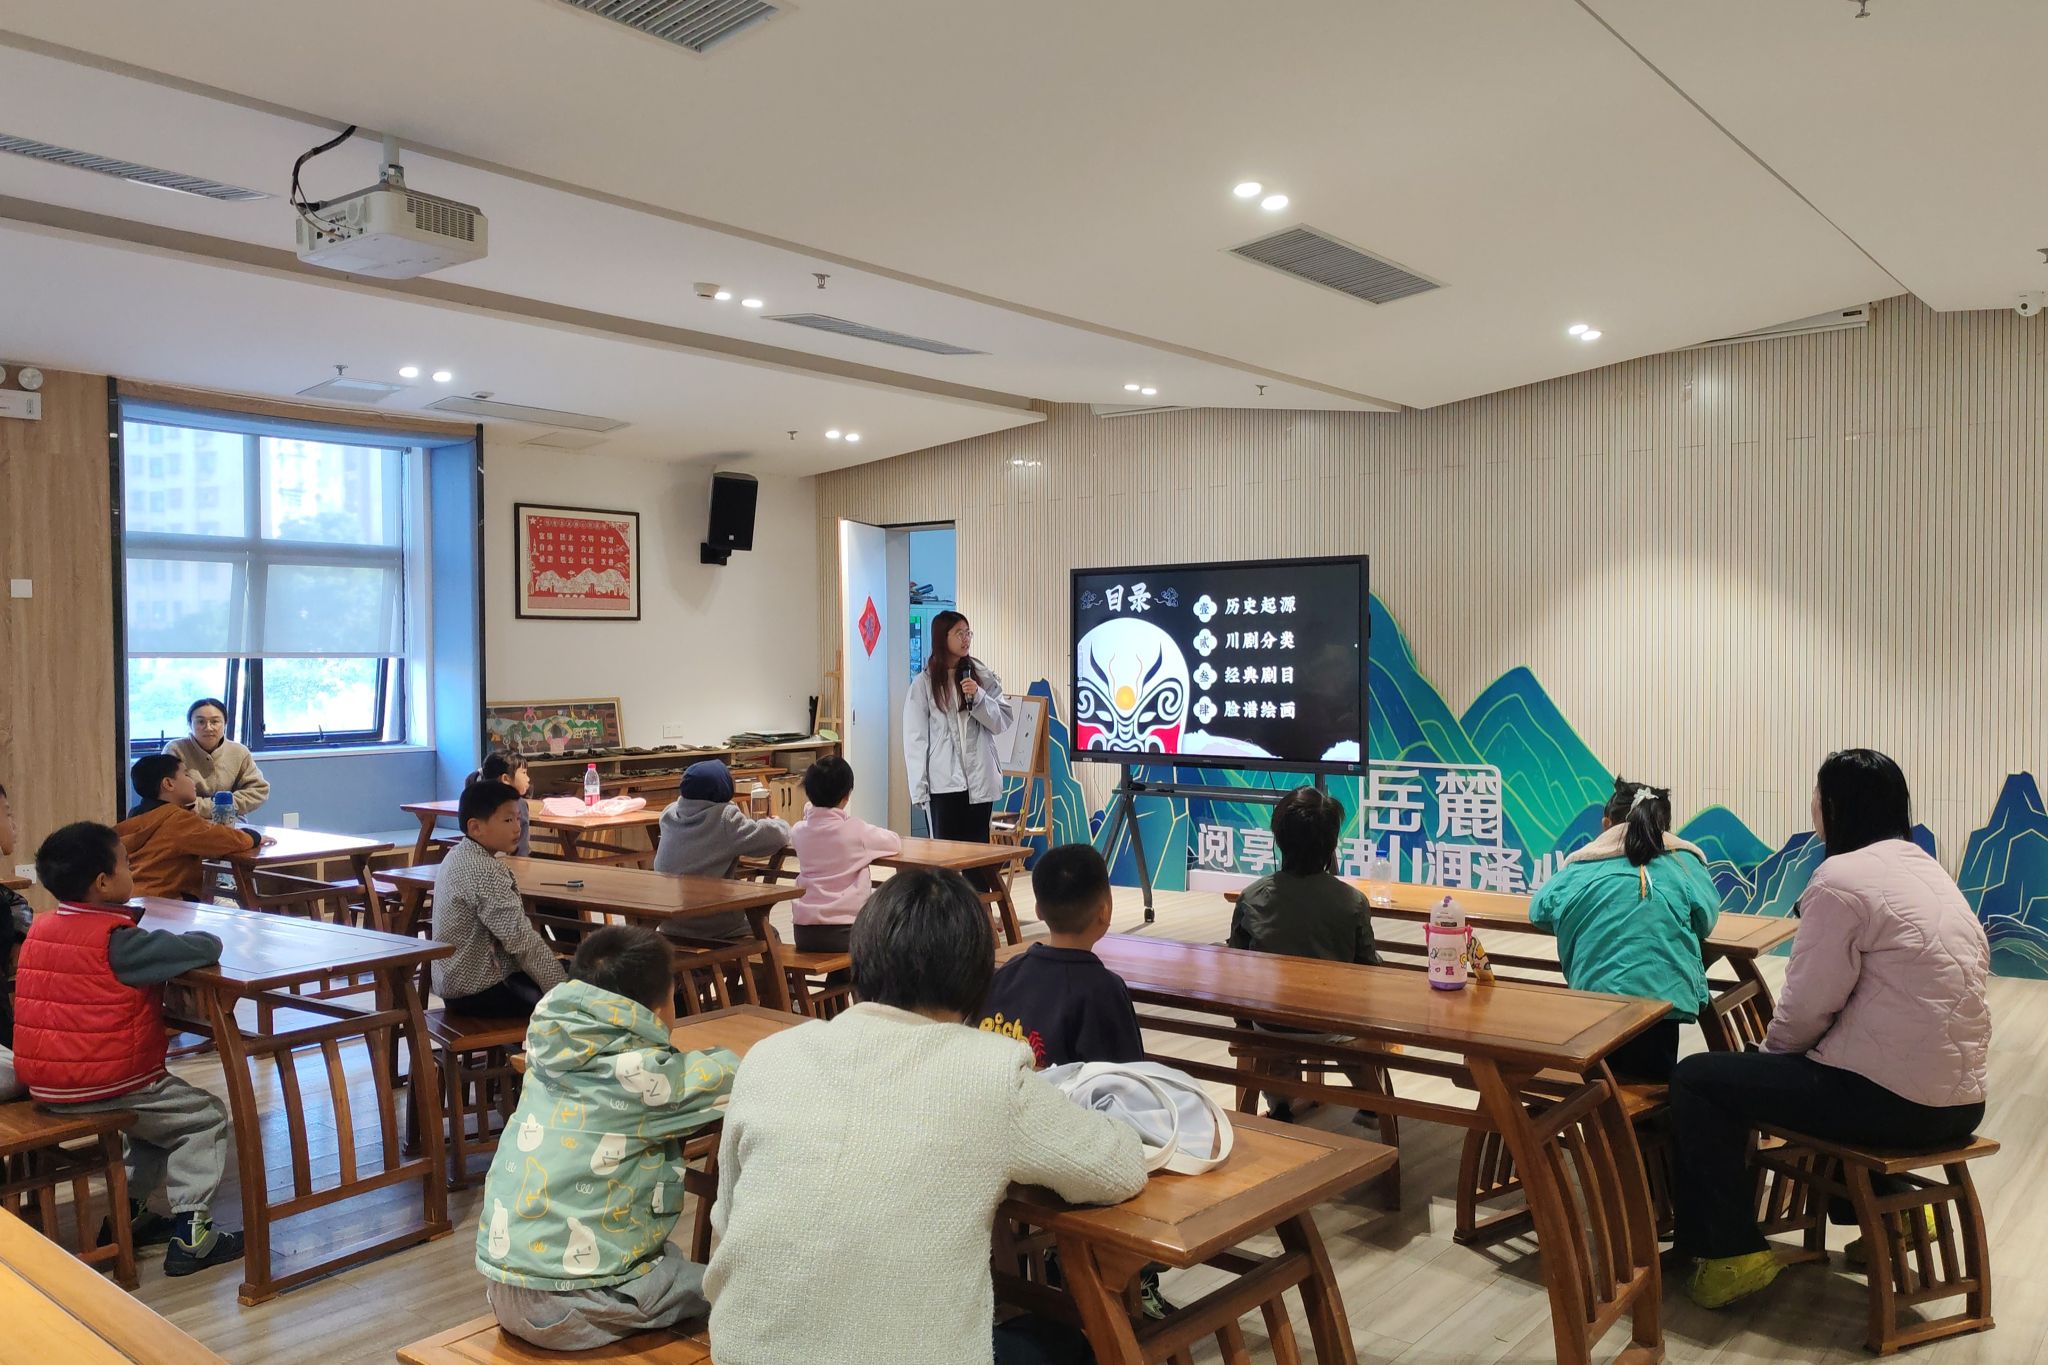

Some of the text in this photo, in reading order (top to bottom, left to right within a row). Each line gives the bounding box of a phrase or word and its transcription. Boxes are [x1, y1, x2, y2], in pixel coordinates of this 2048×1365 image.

[1106, 582, 1151, 613] 目录
[1224, 595, 1297, 615] 历史起源
[1225, 631, 1296, 650] 川剧分类
[1225, 666, 1295, 685] 经典剧目
[1224, 700, 1296, 720] 脸谱绘画
[1367, 768, 1499, 840] 岳麓
